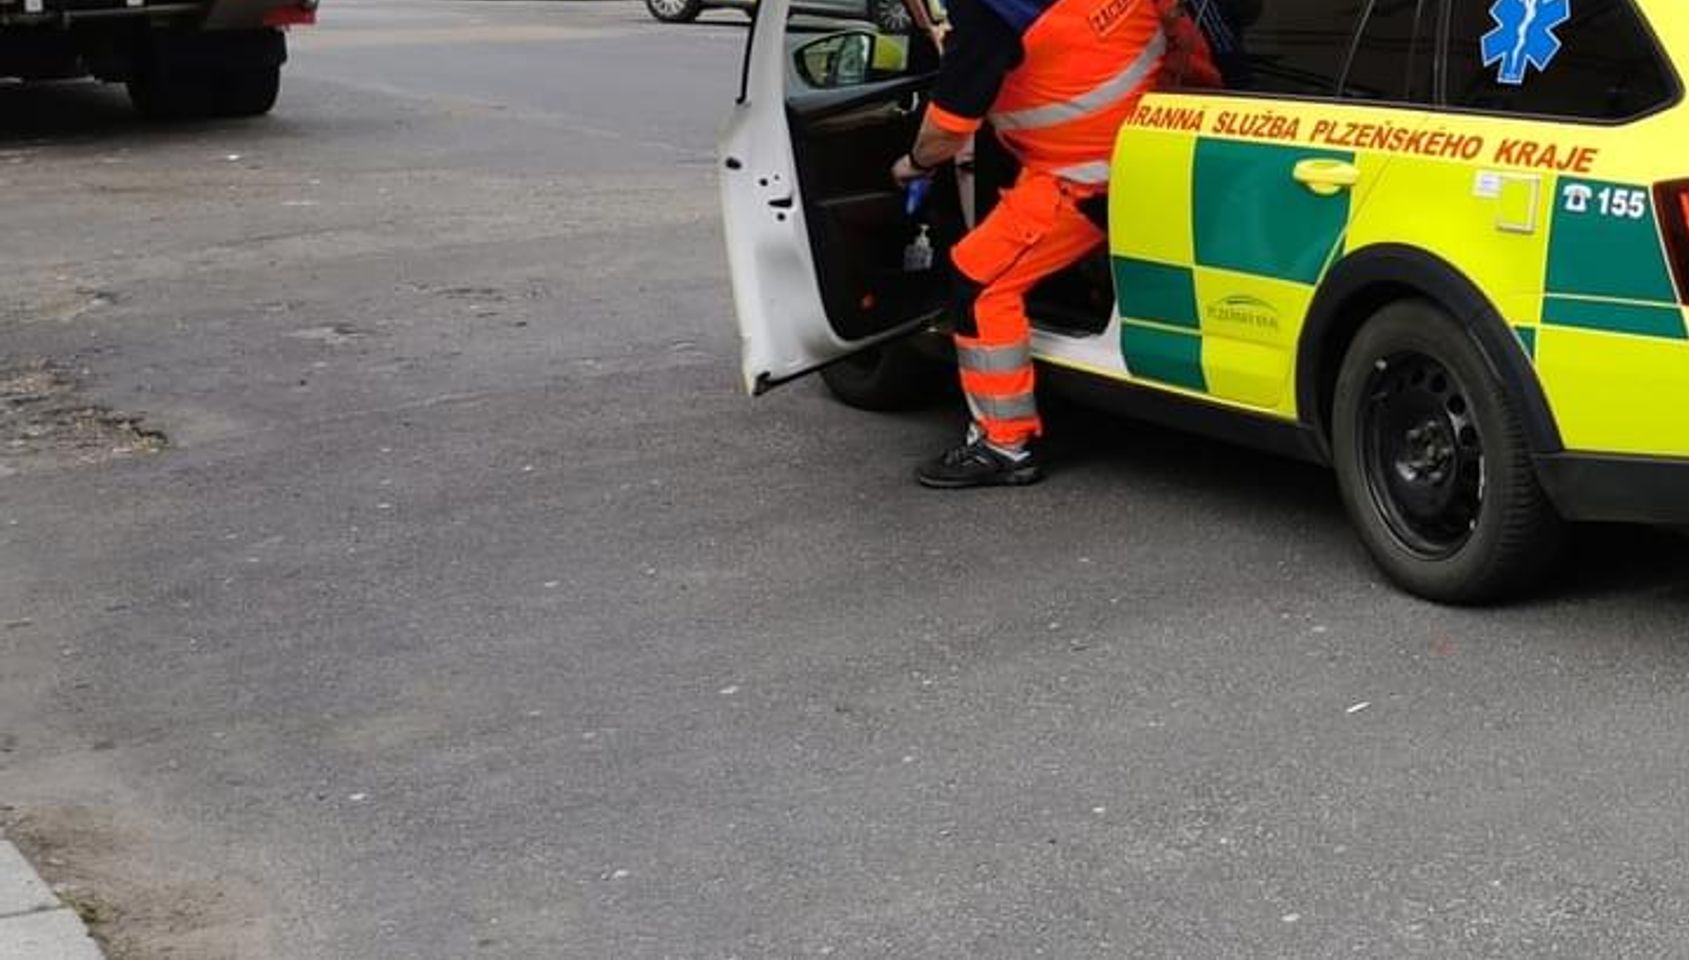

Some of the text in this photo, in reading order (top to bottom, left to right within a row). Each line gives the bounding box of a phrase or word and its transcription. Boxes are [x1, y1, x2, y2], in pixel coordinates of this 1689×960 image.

[1127, 104, 1598, 173] RANNÁ SLUŽBA PLZEŇSKÉHO KRAJE
[1597, 187, 1647, 218] 155
